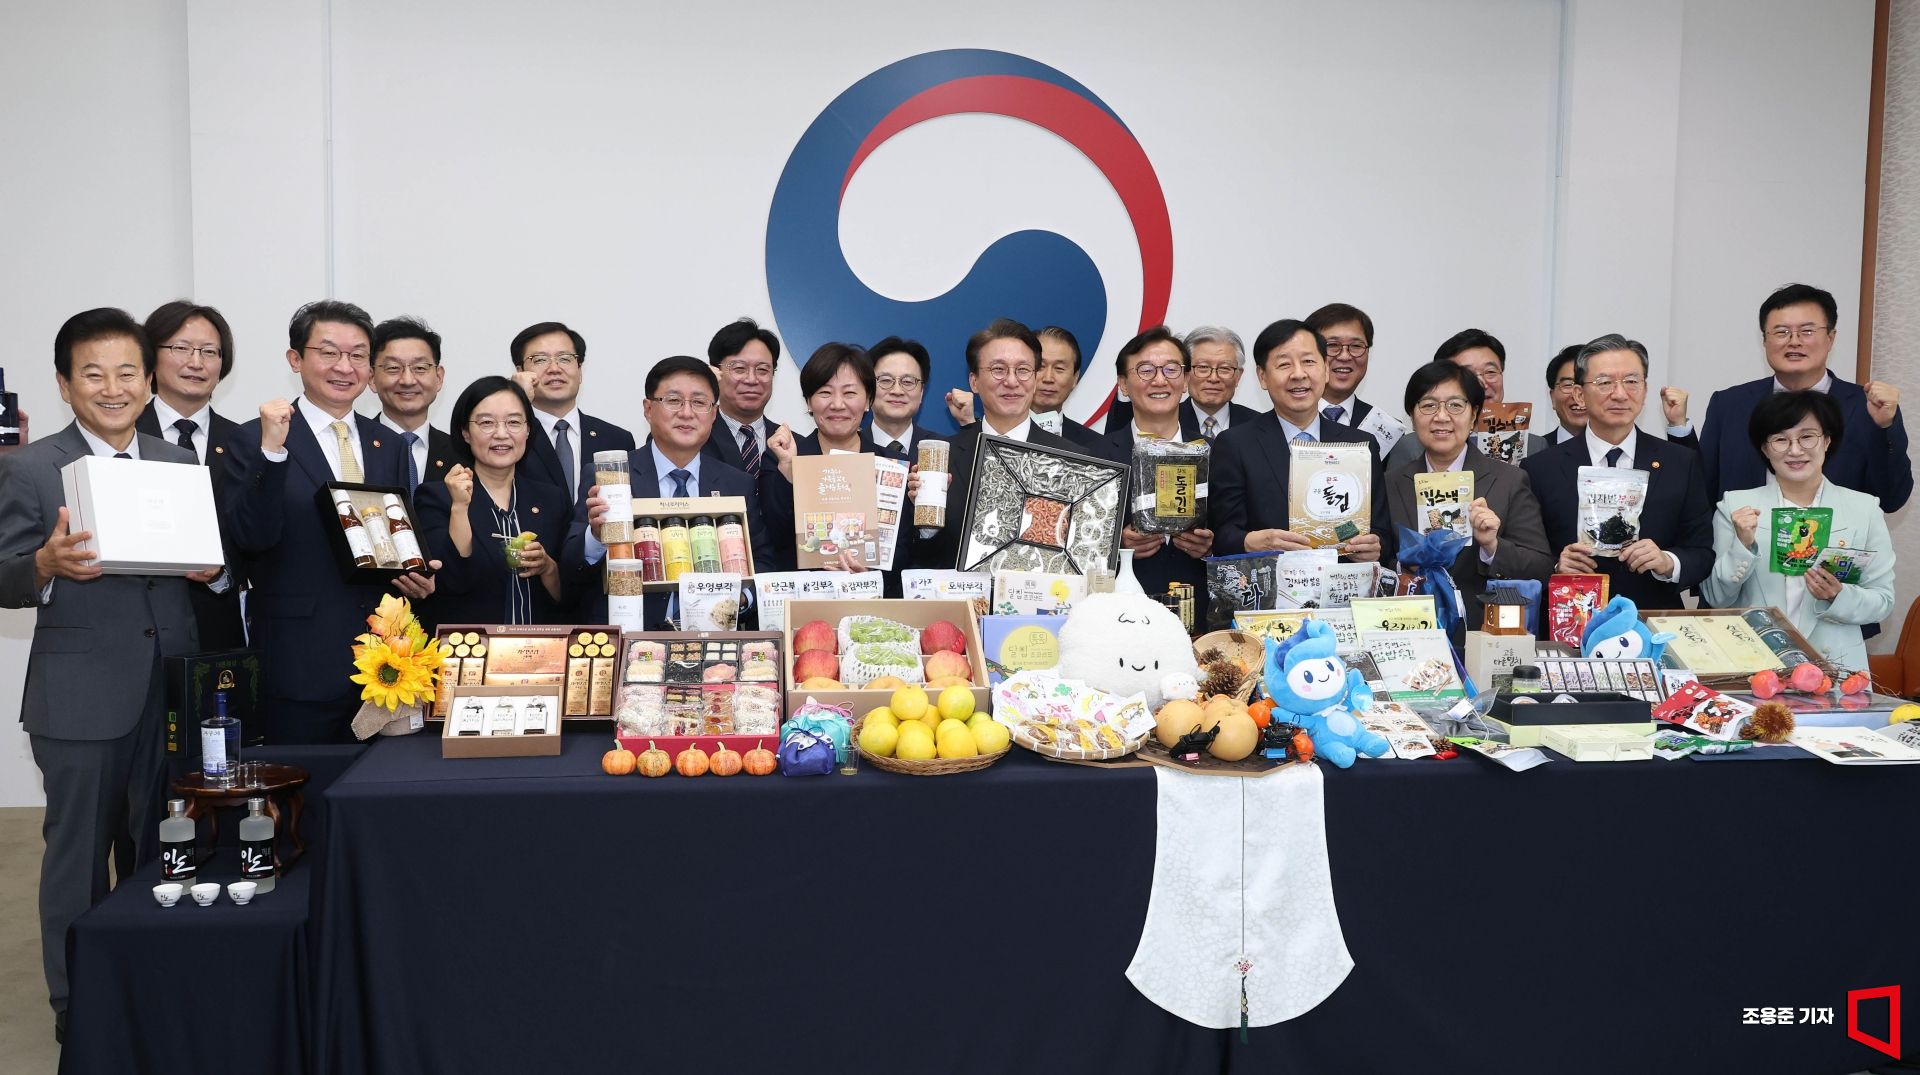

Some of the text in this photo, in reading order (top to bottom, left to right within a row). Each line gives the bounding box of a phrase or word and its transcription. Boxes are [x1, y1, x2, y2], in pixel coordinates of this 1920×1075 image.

[1175, 475, 1188, 514] 돌김
[1322, 485, 1351, 514] 돌김
[1420, 489, 1458, 507] 김스낵
[696, 582, 734, 593] 우엉부각
[771, 581, 796, 592] 당근부
[848, 580, 878, 591] 감자부각
